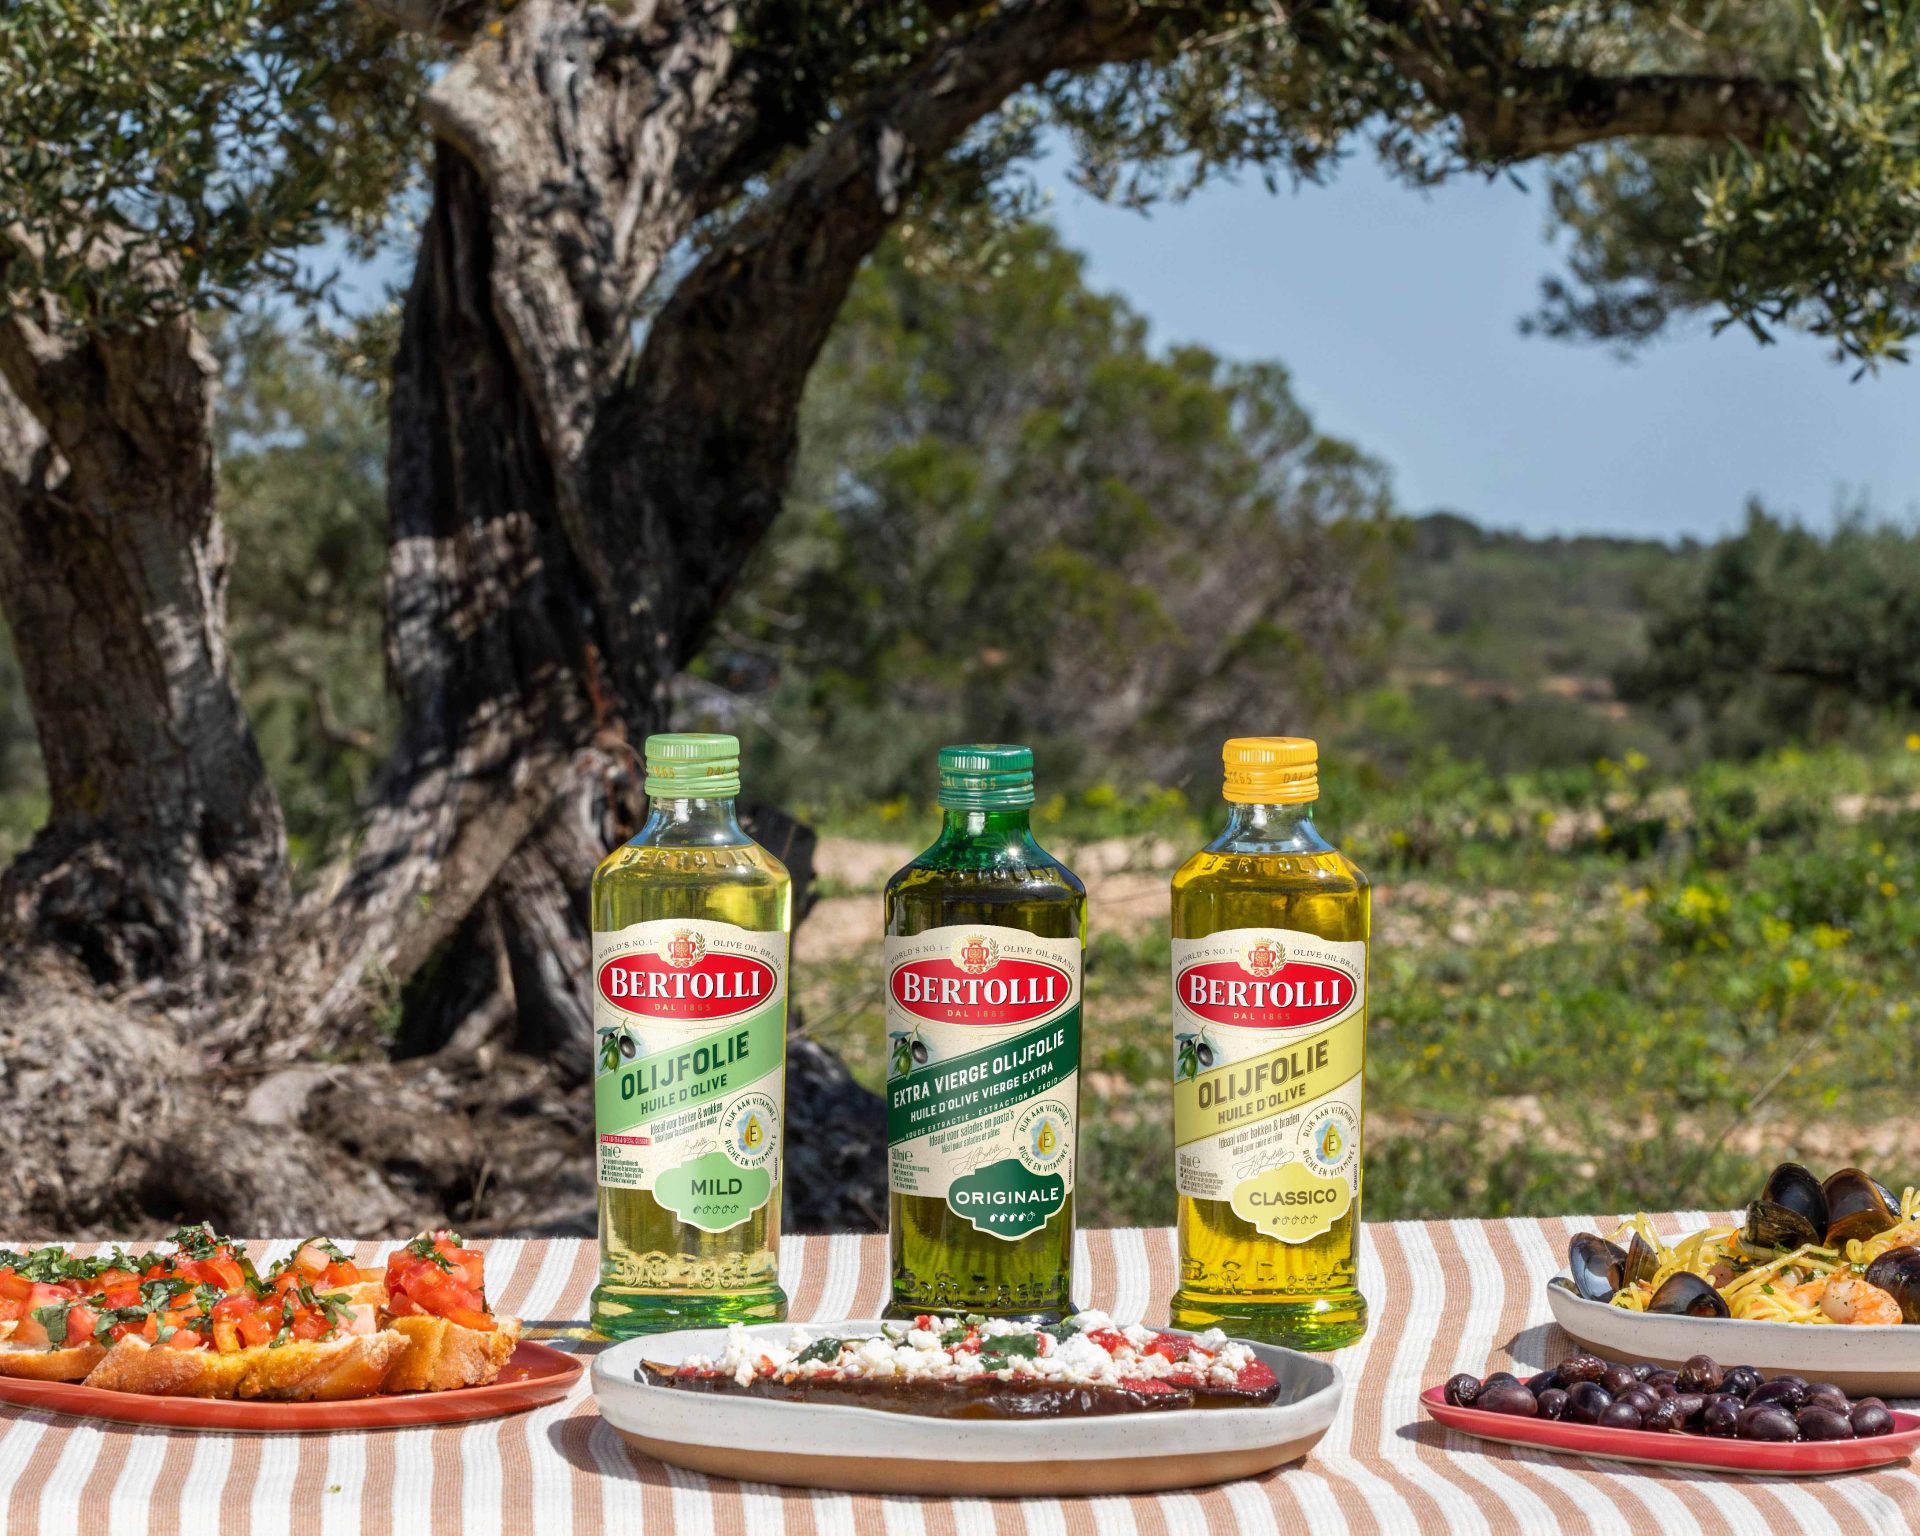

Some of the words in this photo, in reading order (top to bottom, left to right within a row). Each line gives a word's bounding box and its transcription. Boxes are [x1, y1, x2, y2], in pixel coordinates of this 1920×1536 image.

[598, 941, 630, 959] WORLD'S
[713, 939, 743, 949] OLIVE
[744, 943, 759, 953] OIL
[760, 947, 782, 971] BRAND
[890, 946, 920, 965] WORLD'S
[1003, 945, 1033, 955] OLIVE
[1035, 949, 1049, 958] OIL
[1051, 952, 1075, 973] BRAND
[1178, 949, 1210, 966] WORLD'S
[1293, 949, 1322, 959] OLIVE
[1324, 953, 1338, 962] OIL
[1340, 958, 1361, 980] BRAND
[610, 967, 761, 999] BERTOLLI
[903, 971, 1055, 1005] BERTOLLI
[1189, 974, 1341, 1008] BERTOLLI
[654, 1003, 676, 1011] DAL
[683, 1003, 711, 1011] 1865
[947, 1009, 969, 1018] DAL
[976, 1010, 1005, 1018] 1865
[1233, 1012, 1255, 1020] DAL
[1262, 1012, 1291, 1020] 1865
[621, 1030, 750, 1101] OLIJFOLIE
[893, 1081, 930, 1109] EXTRA
[934, 1061, 989, 1094] VIERGE
[992, 1028, 1065, 1074] OLIJFOLIE
[1198, 1039, 1330, 1110] OLIJFOLIE
[641, 1091, 676, 1115] HUILE
[679, 1073, 728, 1102] D'OLIVE
[910, 1103, 937, 1123] HUILE
[939, 1089, 979, 1113] D'OLIVE
[981, 1076, 1020, 1099] VIERGE
[1022, 1061, 1053, 1084] EXTRA
[1218, 1101, 1253, 1125] HUILE
[1256, 1083, 1306, 1112] D'OLIVE
[725, 1110, 737, 1127] RIJK
[737, 1098, 750, 1111] AAN
[752, 1098, 776, 1117] VITAMINE
[905, 1127, 926, 1140] KOUDE
[928, 1113, 969, 1133] EXTRACTIE
[978, 1092, 1028, 1115] EXTRACTION
[1038, 1077, 1058, 1092] FROID
[1020, 1115, 1031, 1132] RIJK
[1031, 1105, 1044, 1118] AAN
[1045, 1104, 1070, 1122] VITAMINE
[1303, 1119, 1315, 1137] RIJK
[1315, 1108, 1329, 1121] AAN
[1330, 1106, 1354, 1126] VITAMINE
[750, 1125, 757, 1142] E
[929, 1132, 945, 1147] Ideaal
[946, 1129, 959, 1142] voor
[960, 1121, 983, 1137] salades
[984, 1118, 991, 1128] en
[993, 1109, 1014, 1127] pasta's
[1043, 1131, 1051, 1148] E
[1250, 1123, 1272, 1139] bakken
[1279, 1113, 1300, 1129] braden
[725, 1139, 740, 1161] RICHE
[740, 1157, 749, 1166] EN
[751, 1141, 776, 1167] VITAMINE
[1328, 1134, 1336, 1152] E
[1019, 1145, 1033, 1166] RICHE
[1033, 1162, 1042, 1172] EN
[1043, 1149, 1068, 1172] VITAMINE
[1303, 1149, 1318, 1172] RICHE
[1318, 1167, 1327, 1177] EN
[1329, 1150, 1355, 1176] VITAMINE
[691, 1178, 742, 1196] MILD
[955, 1187, 1059, 1205] ORIGINALE
[1249, 1188, 1337, 1206] CLASSICO
